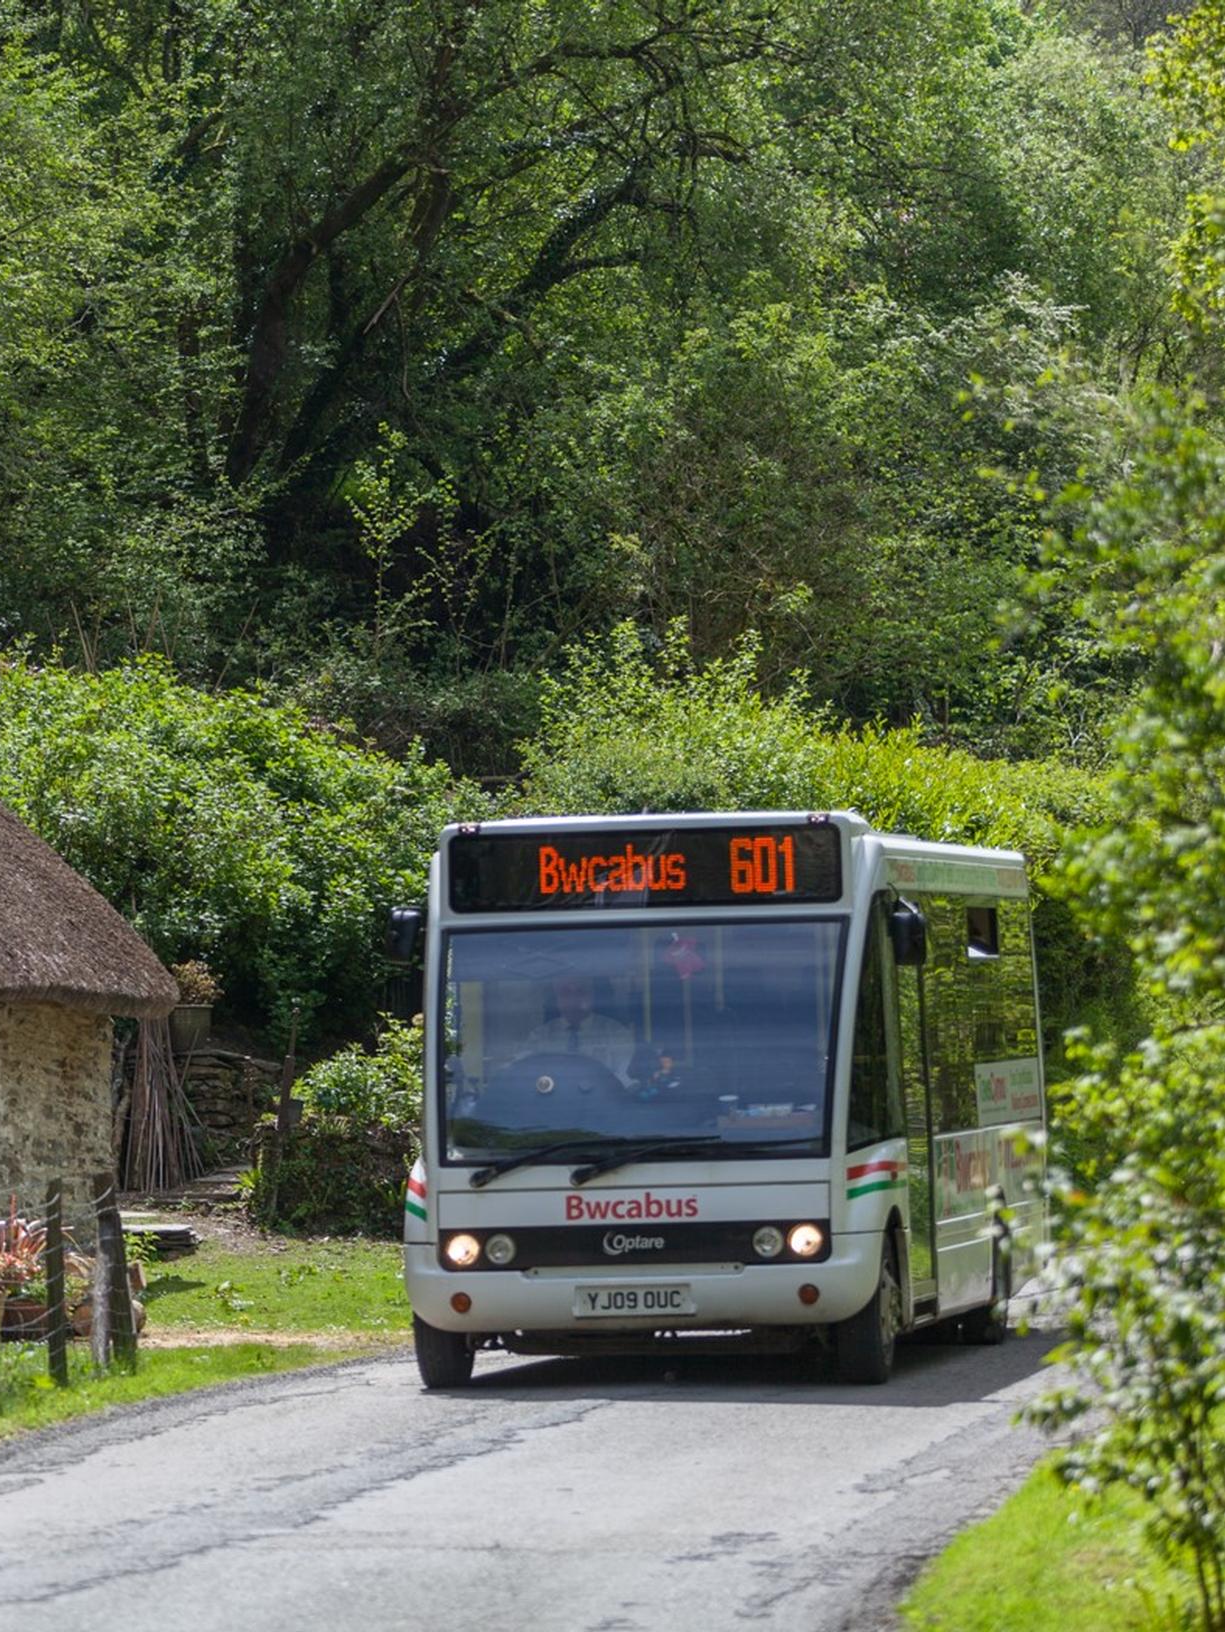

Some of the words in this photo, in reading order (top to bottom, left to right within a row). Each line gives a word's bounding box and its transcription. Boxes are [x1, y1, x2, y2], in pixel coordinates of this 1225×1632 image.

[540, 845, 687, 894] Bwcabus
[730, 836, 795, 893] 601
[566, 1192, 698, 1220] Bwcabus
[608, 1233, 665, 1254] Optare
[587, 1291, 639, 1310] YJ09
